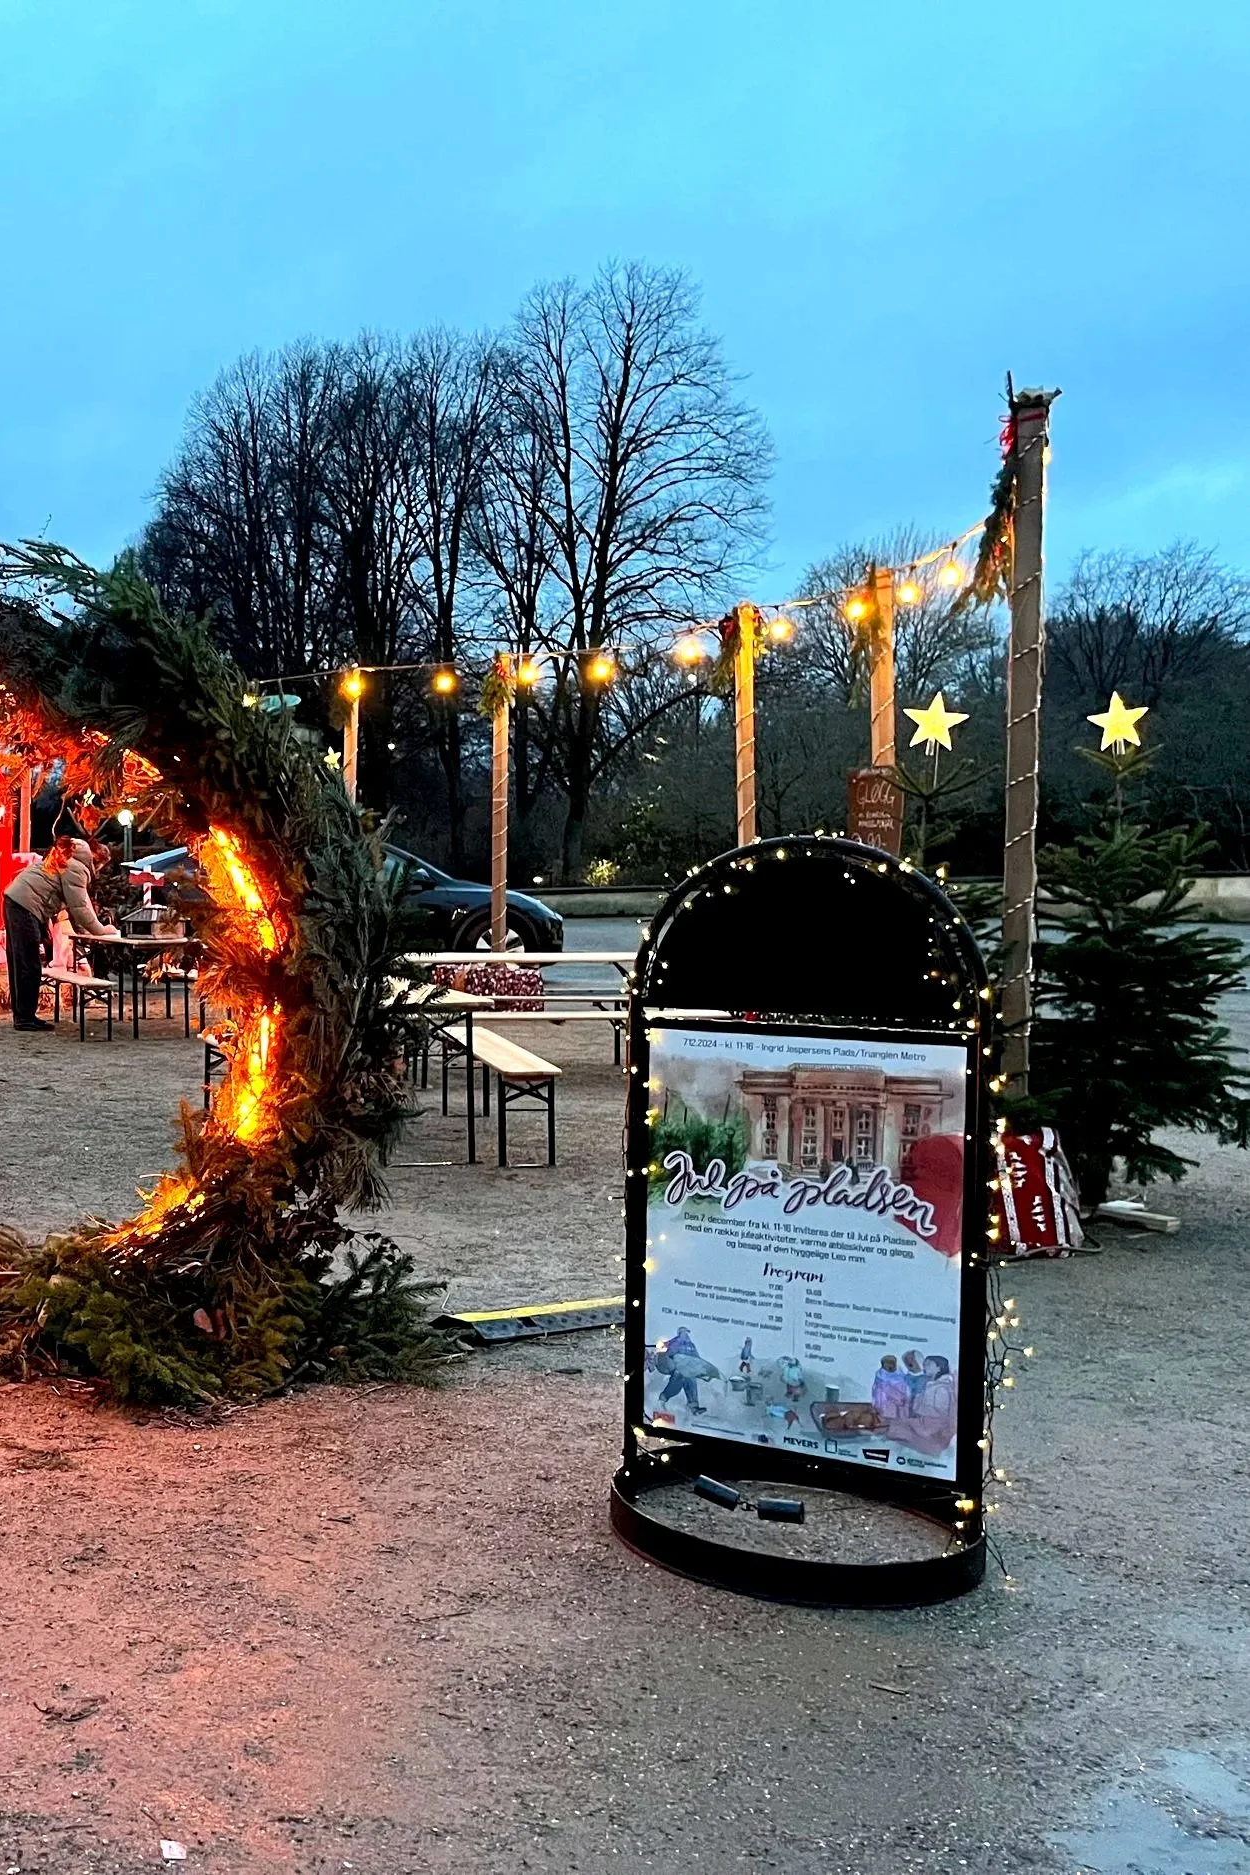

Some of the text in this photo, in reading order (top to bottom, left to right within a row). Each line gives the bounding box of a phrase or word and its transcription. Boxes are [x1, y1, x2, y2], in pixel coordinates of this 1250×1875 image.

[857, 780, 895, 808] GLØGG
[761, 1043, 784, 1053] Ingrid
[786, 1045, 831, 1057] Jespersens
[901, 1051, 926, 1062] Metro
[666, 1152, 933, 1232] Jul på pladsen
[684, 1212, 699, 1221] Den
[707, 1215, 746, 1227] december
[748, 1219, 760, 1229] fra
[847, 1231, 855, 1240] til
[857, 1232, 868, 1241] Jul
[870, 1234, 880, 1243] på
[685, 1223, 702, 1233] med
[703, 1225, 713, 1234] en
[800, 1238, 827, 1248] varme
[876, 1246, 887, 1256] og
[726, 1240, 736, 1249] og
[738, 1240, 762, 1252] besøg
[763, 1244, 772, 1252] af
[774, 1245, 789, 1254] den
[790, 1246, 829, 1260] hyggelige
[831, 1252, 846, 1261] Leo
[763, 1262, 825, 1283] Program
[783, 1436, 819, 1449] MEYERS
